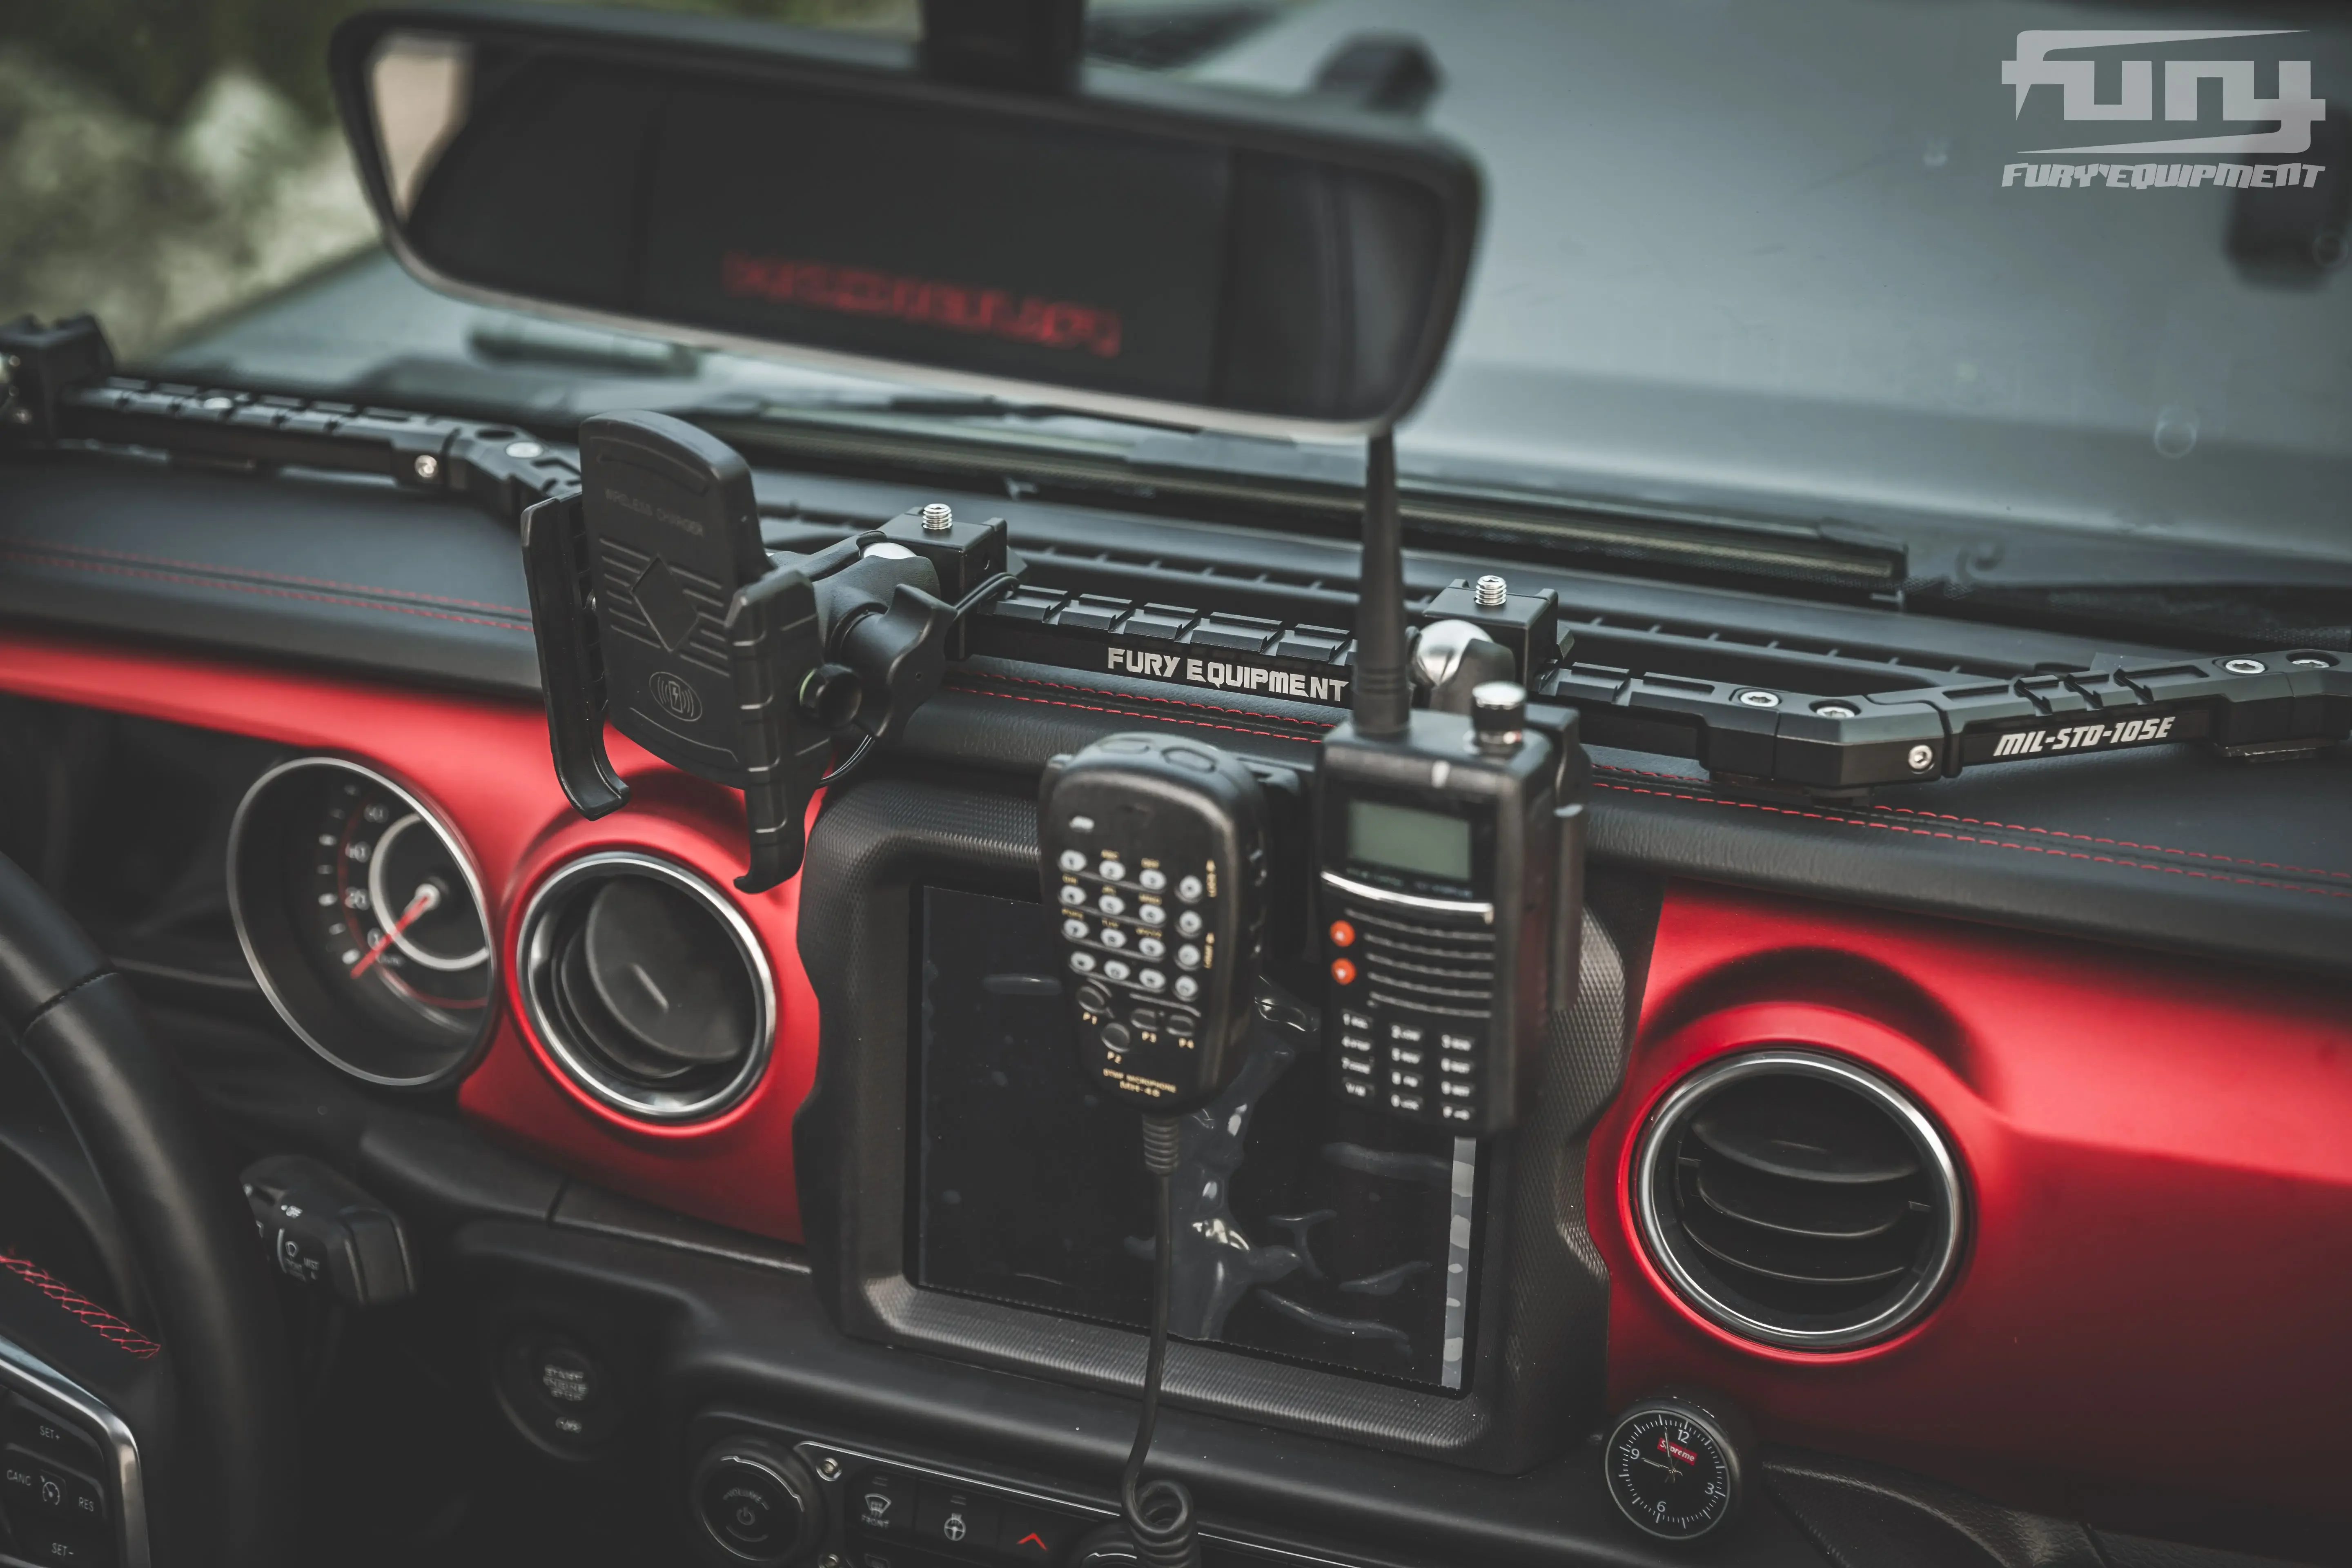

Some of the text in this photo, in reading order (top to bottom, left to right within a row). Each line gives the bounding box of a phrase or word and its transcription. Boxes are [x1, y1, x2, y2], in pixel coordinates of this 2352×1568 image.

[1108, 647, 1349, 702] FURY EQUIPMENT
[1993, 716, 2176, 756] MIL-STD-105E
[1083, 1012, 1098, 1025] P1
[1107, 1051, 1122, 1064] P2
[1678, 1429, 1690, 1444] 12
[1630, 1448, 1640, 1460] 9
[1659, 1440, 1695, 1461] Spreme
[6, 1469, 31, 1486] CANC
[1704, 1482, 1714, 1495] 3
[78, 1497, 94, 1512] RES
[1657, 1501, 1666, 1512] 6
[860, 1513, 890, 1530] FRONT
